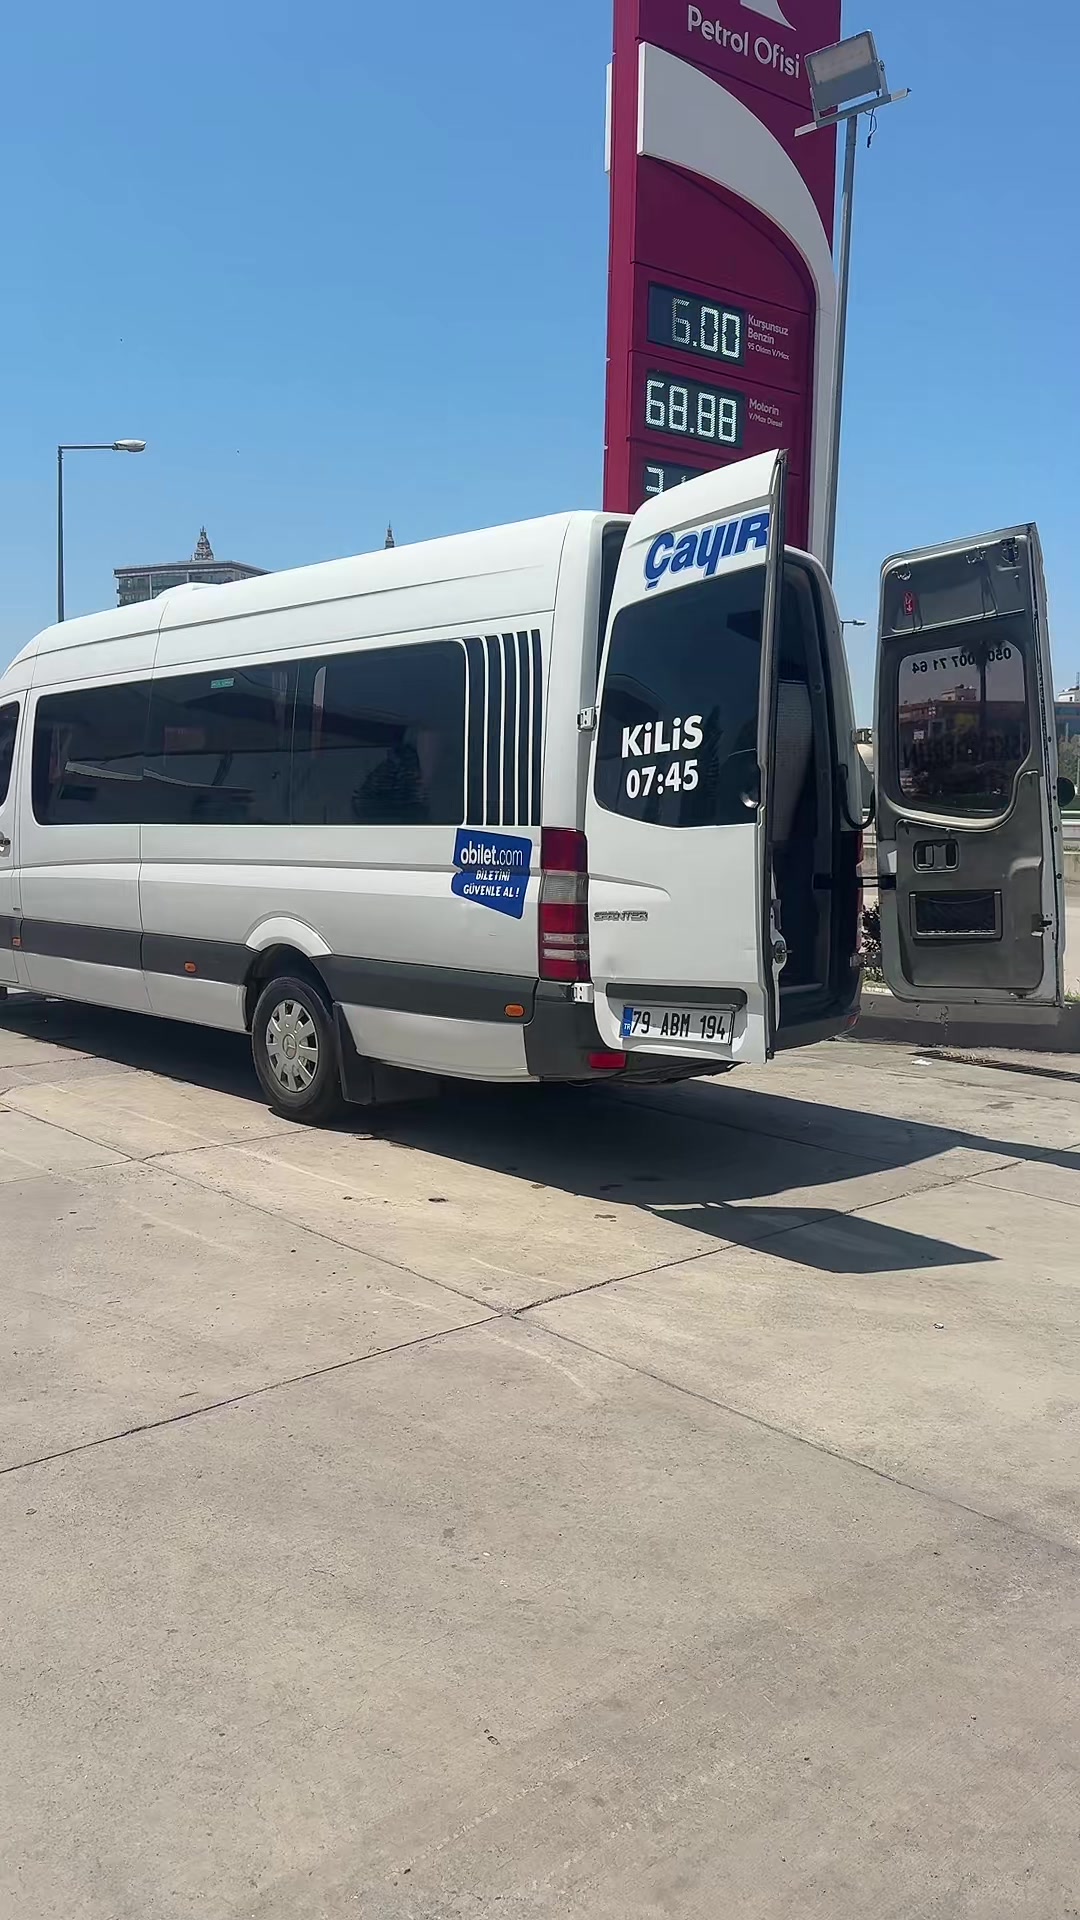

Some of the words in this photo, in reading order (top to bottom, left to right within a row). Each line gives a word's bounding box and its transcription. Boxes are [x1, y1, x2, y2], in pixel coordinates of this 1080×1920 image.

[687, 4, 749, 57] Petrol
[754, 37, 801, 79] Ofisi
[747, 327, 775, 345] Benzin
[748, 313, 789, 336] Kurşunsuz
[645, 379, 737, 443] 68.88
[749, 397, 780, 416] Motorin
[621, 714, 704, 759] KiLiS
[626, 758, 699, 799] 07:45
[460, 840, 523, 866] obilet.com
[463, 882, 502, 897] GÜVENLE
[593, 910, 649, 922] SPRINTER
[631, 1011, 651, 1034] 79
[660, 1012, 691, 1038] ABM
[700, 1015, 726, 1040] 194
